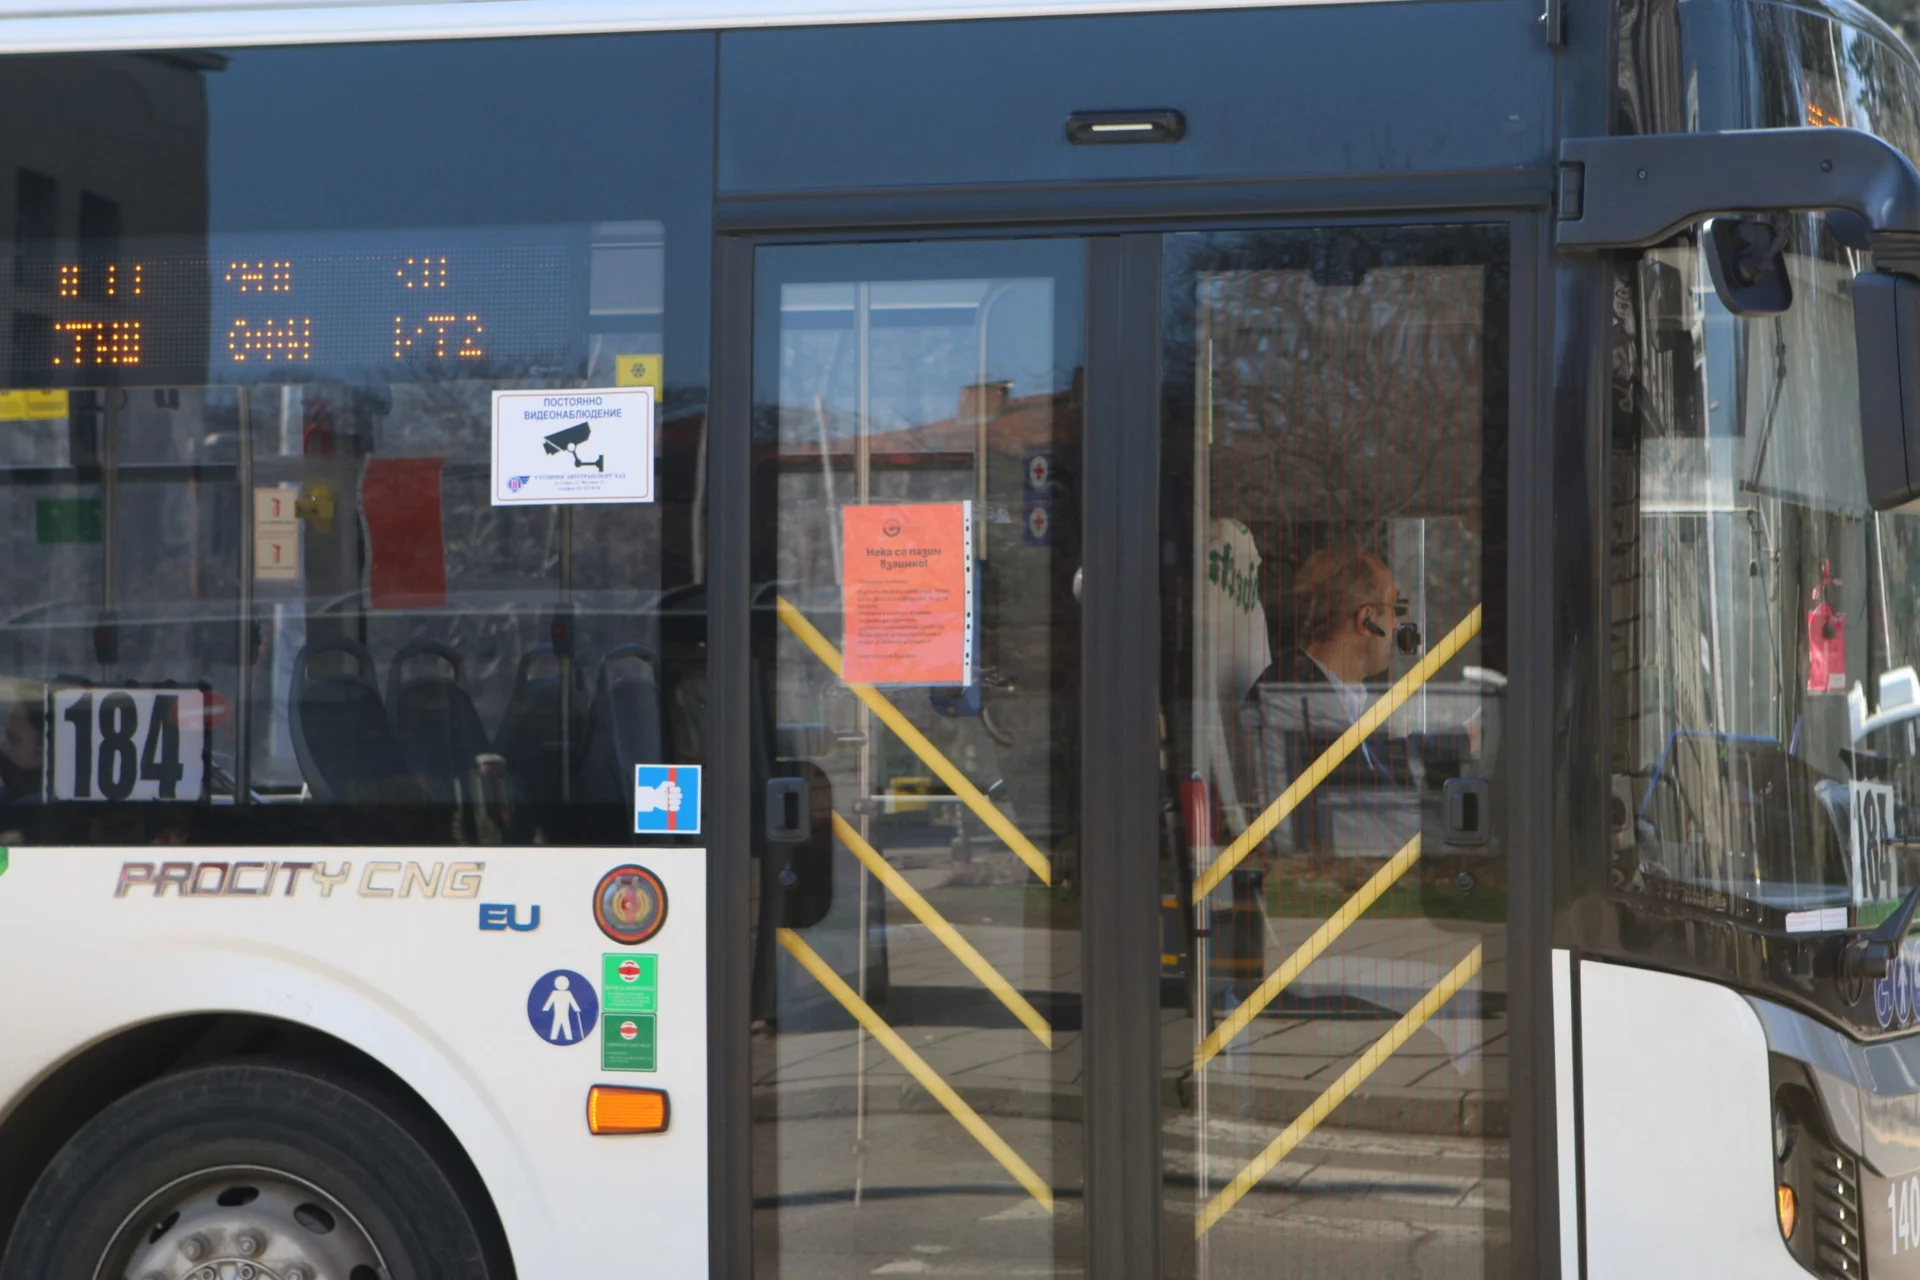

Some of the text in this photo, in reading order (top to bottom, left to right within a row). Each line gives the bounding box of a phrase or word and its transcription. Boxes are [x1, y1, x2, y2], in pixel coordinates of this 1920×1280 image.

[543, 396, 603, 408] ПОСТОЯННО
[524, 408, 623, 421] ВИДЕОНАБЛЮДЕНИЕ
[866, 547, 942, 558] Нека се пазим
[880, 558, 928, 571] взаимно!
[64, 691, 184, 801] 184
[1853, 788, 1892, 901] 184
[114, 861, 486, 898] PROCITY CNG
[478, 902, 541, 931] EU
